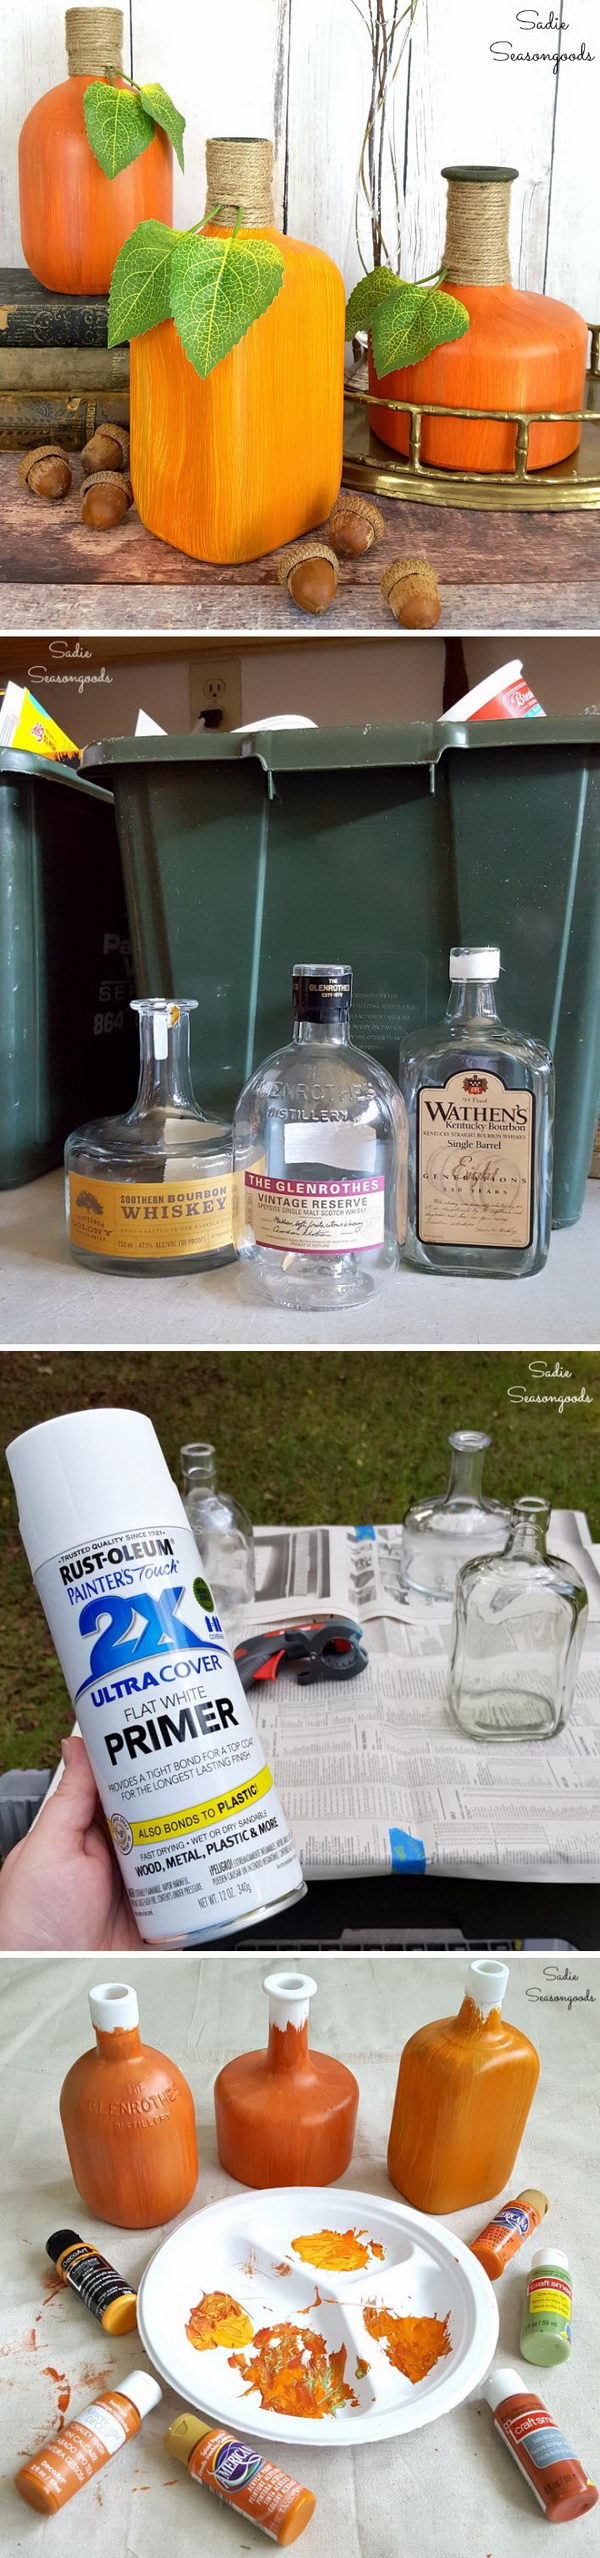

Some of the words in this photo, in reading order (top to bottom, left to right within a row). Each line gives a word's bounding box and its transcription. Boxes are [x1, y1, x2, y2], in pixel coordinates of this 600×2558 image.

[93, 1011, 125, 1035] 864
[266, 1107, 348, 1123] DISTILLERY
[424, 1101, 528, 1125] WATHEN'S
[445, 1121, 486, 1132] Kentucky
[488, 1122, 526, 1132] Bourbon
[447, 1139, 475, 1150] Single
[476, 1141, 502, 1150] Barrel
[249, 1174, 271, 1190] THE
[276, 1179, 380, 1195] GLENROTHES
[422, 1173, 528, 1185] GENERATIONS
[120, 1194, 165, 1204] SOUTHERN
[167, 1186, 228, 1204] BOURBON
[257, 1193, 308, 1209] VINTAGE
[312, 1197, 368, 1209] RESERVE
[121, 1196, 228, 1220] WHISKEY
[258, 1203, 281, 1213] SPEYSIDE
[281, 1206, 301, 1215] SINGLE
[303, 1208, 319, 1216] MALT
[321, 1207, 345, 1216] SCOTCH
[92, 1536, 124, 1550] QUALITY
[125, 1531, 147, 1541] SINCE
[66, 1568, 134, 1606] PAINTER'S
[131, 1559, 180, 1582] Touch
[78, 1586, 205, 1674] 2X
[90, 1671, 159, 1708] ULTRA
[159, 1654, 223, 1682] COVER
[124, 1699, 157, 1722] FLAT
[160, 1685, 207, 1709] WHITE
[104, 1697, 239, 1766] PRIMER
[108, 1777, 138, 1793] PROVIDES
[139, 1772, 147, 1783] A
[146, 1763, 172, 1781] TIGHT
[173, 1754, 201, 1771] BOND
[202, 1748, 220, 1761] FOR
[221, 1745, 228, 1754] A
[227, 1741, 241, 1752] TOP
[121, 1789, 137, 1801] FOR
[137, 1784, 153, 1796] THE
[152, 1771, 195, 1791] LONGEST
[195, 1757, 231, 1776] LASTING
[231, 1750, 252, 1763] FINISH
[138, 1828, 163, 1840] ALSO
[163, 1815, 201, 1835] BONDS
[201, 1808, 216, 1822] TO
[217, 1784, 260, 1815] PLASTIC!
[135, 1861, 166, 1878] WOOD,
[165, 1848, 206, 1870] METAL,
[206, 1828, 250, 1857] PLASTIC
[250, 1825, 259, 1839] &
[258, 1816, 279, 1833] MORE
[140, 1851, 156, 1862] FAST
[155, 1840, 186, 1860] DRYING
[190, 1834, 209, 1847] WET
[209, 1830, 222, 1842] OR
[222, 1823, 237, 1836] DRY
[237, 1809, 268, 1829] SANDABLE
[197, 1897, 209, 1910] NET
[209, 1893, 219, 1906] WT.
[219, 1889, 227, 1900] 12
[238, 1881, 252, 1895] 340g
[62, 2247, 89, 2268] DecoArt
[530, 2280, 550, 2290] craft
[515, 2417, 536, 2434] craft
[213, 2444, 252, 2482] AMERICAN
